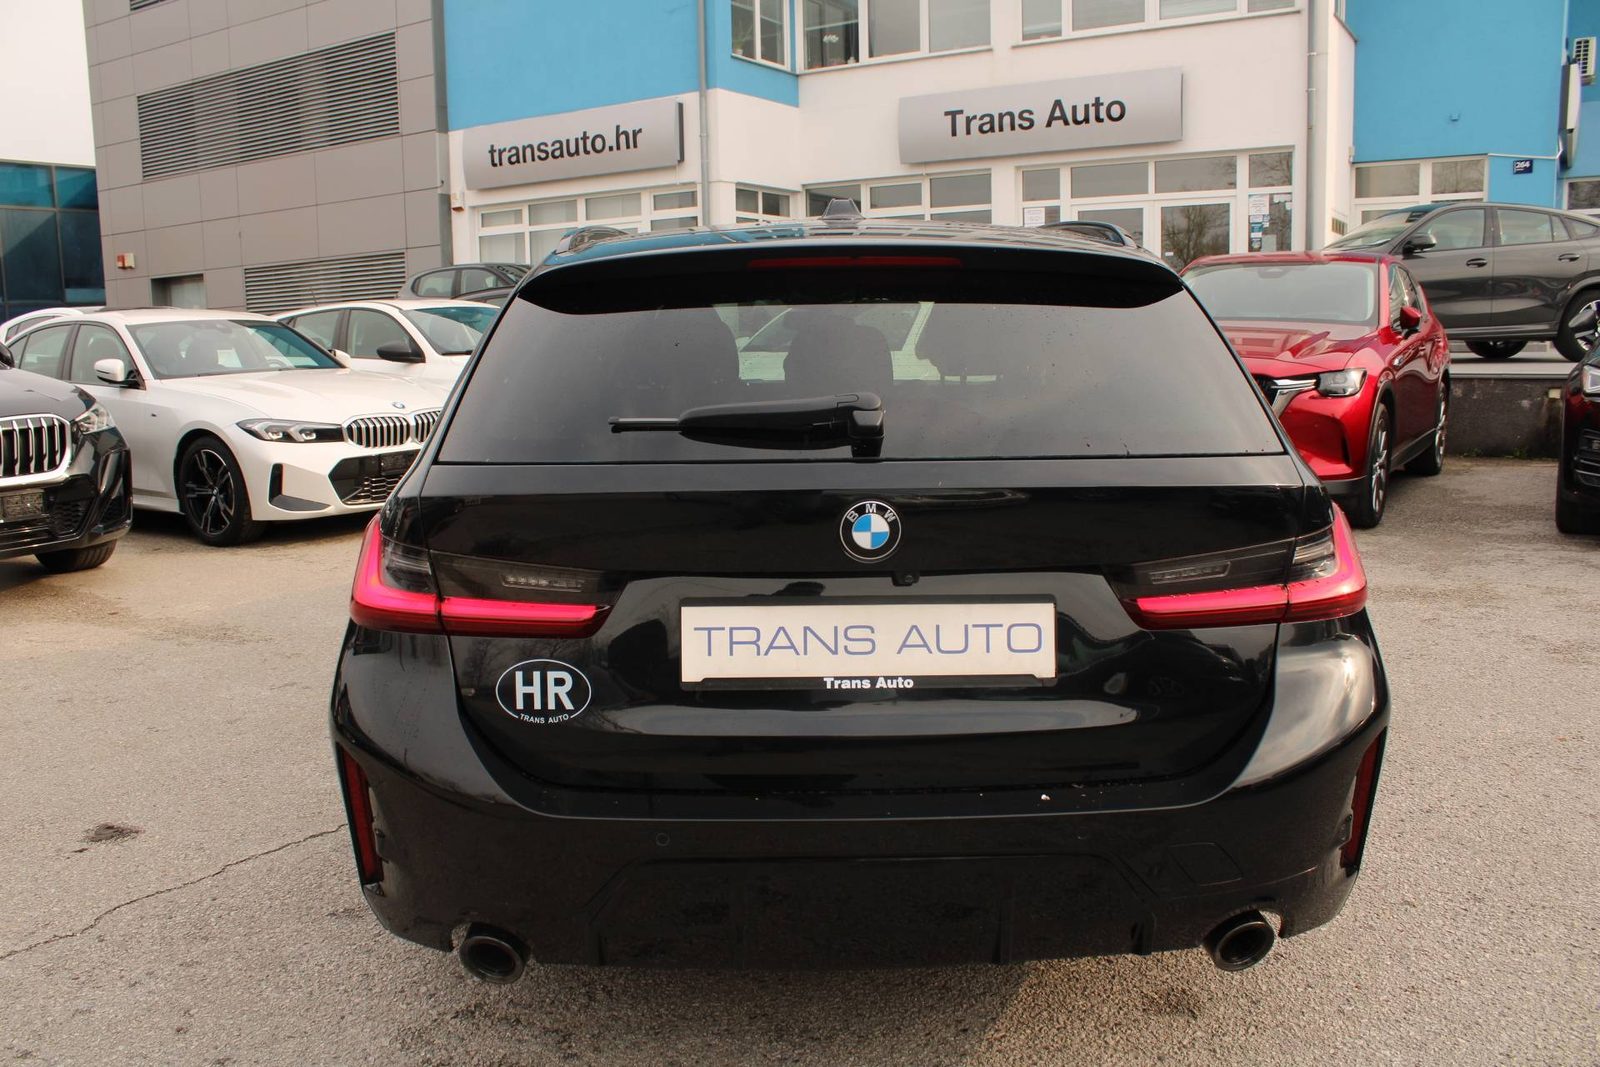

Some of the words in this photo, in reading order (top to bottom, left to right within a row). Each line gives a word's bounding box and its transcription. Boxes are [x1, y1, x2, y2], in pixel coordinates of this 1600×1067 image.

[945, 107, 1036, 137] Trans
[1046, 96, 1125, 128] Auto
[489, 124, 643, 168] transauto.hr
[847, 503, 896, 523] BMW
[693, 624, 877, 657] TRANS
[896, 622, 1044, 656] AUTO
[515, 671, 575, 710] HR
[823, 677, 871, 689] Trans
[875, 676, 914, 689] Auto
[519, 713, 545, 724] TRANS
[548, 713, 569, 724] AUTO
